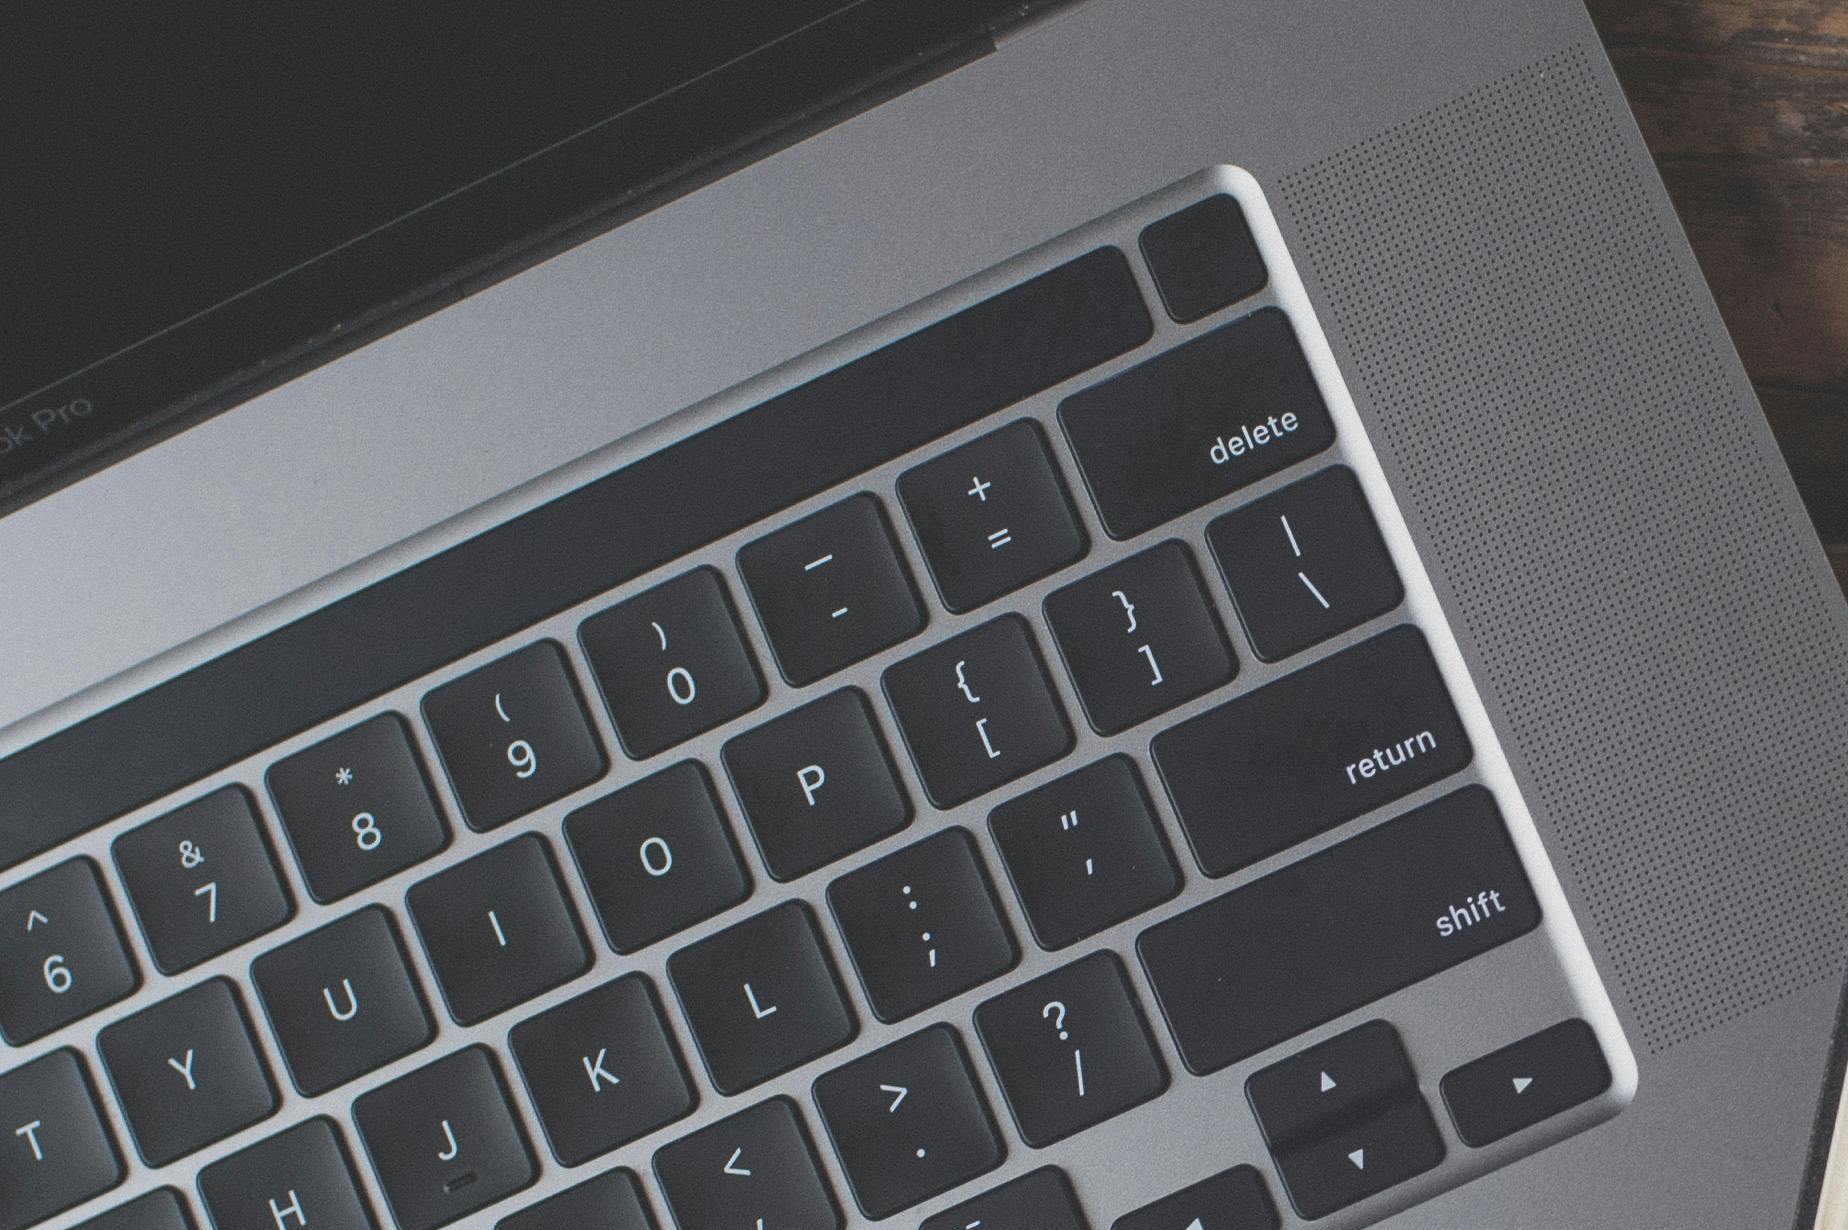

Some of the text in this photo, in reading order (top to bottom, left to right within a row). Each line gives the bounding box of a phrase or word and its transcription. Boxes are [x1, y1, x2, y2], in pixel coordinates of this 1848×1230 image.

[30, 398, 93, 433] Pro
[1209, 409, 1300, 465] delete
[665, 666, 697, 706] 0
[506, 739, 538, 779] 9
[1346, 728, 1437, 786] return
[795, 763, 826, 807] P
[350, 811, 383, 851] 8
[638, 836, 674, 877] O
[193, 881, 218, 924] 7
[1436, 890, 1506, 937] shift
[487, 910, 507, 947] I
[42, 953, 73, 994] 6
[322, 977, 359, 1022] U
[742, 982, 778, 1020] L
[167, 1048, 197, 1091] Y
[581, 1047, 621, 1093] K
[14, 1119, 44, 1161] T
[437, 1119, 458, 1162] J
